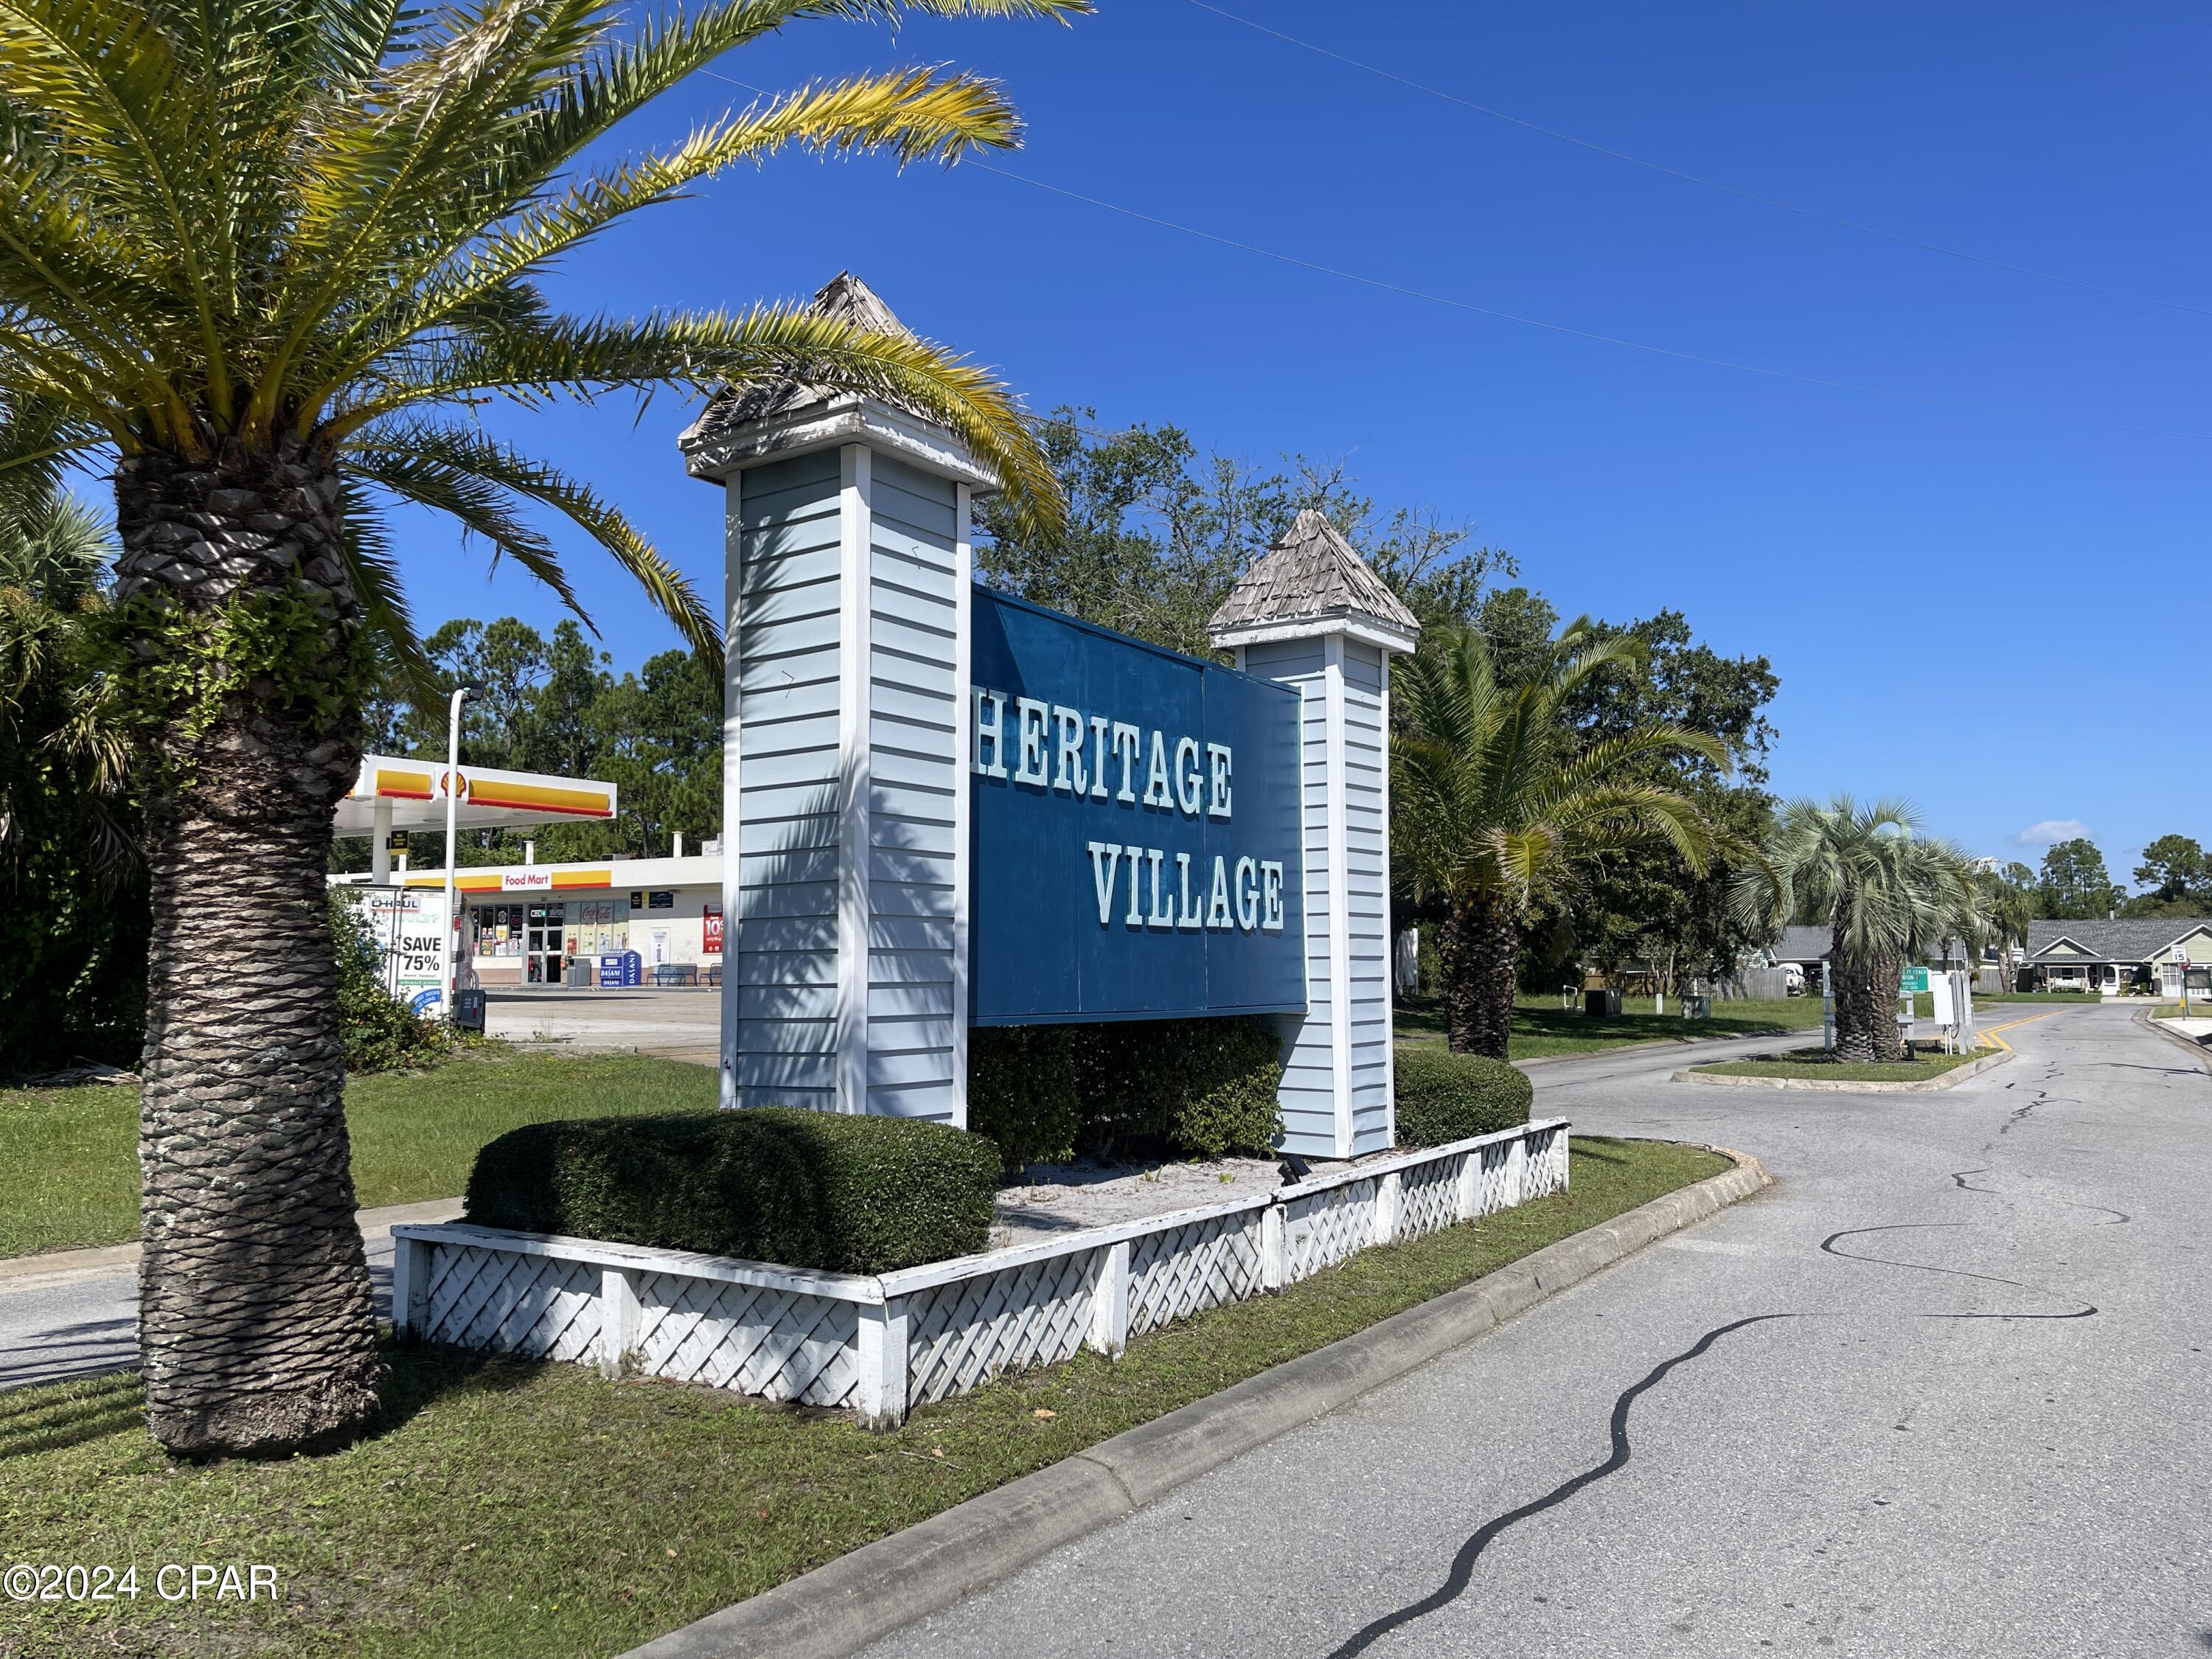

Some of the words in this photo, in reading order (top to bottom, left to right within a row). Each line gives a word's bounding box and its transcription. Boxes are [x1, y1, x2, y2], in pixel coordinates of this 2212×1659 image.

[970, 686, 1231, 817] HERITAGE
[506, 874, 525, 885] Food
[528, 872, 549, 884] Mart
[1087, 841, 1284, 930] VILLAGE
[403, 937, 441, 951] SAVE
[404, 956, 439, 970] 75%
[601, 969, 620, 977] DASANI
